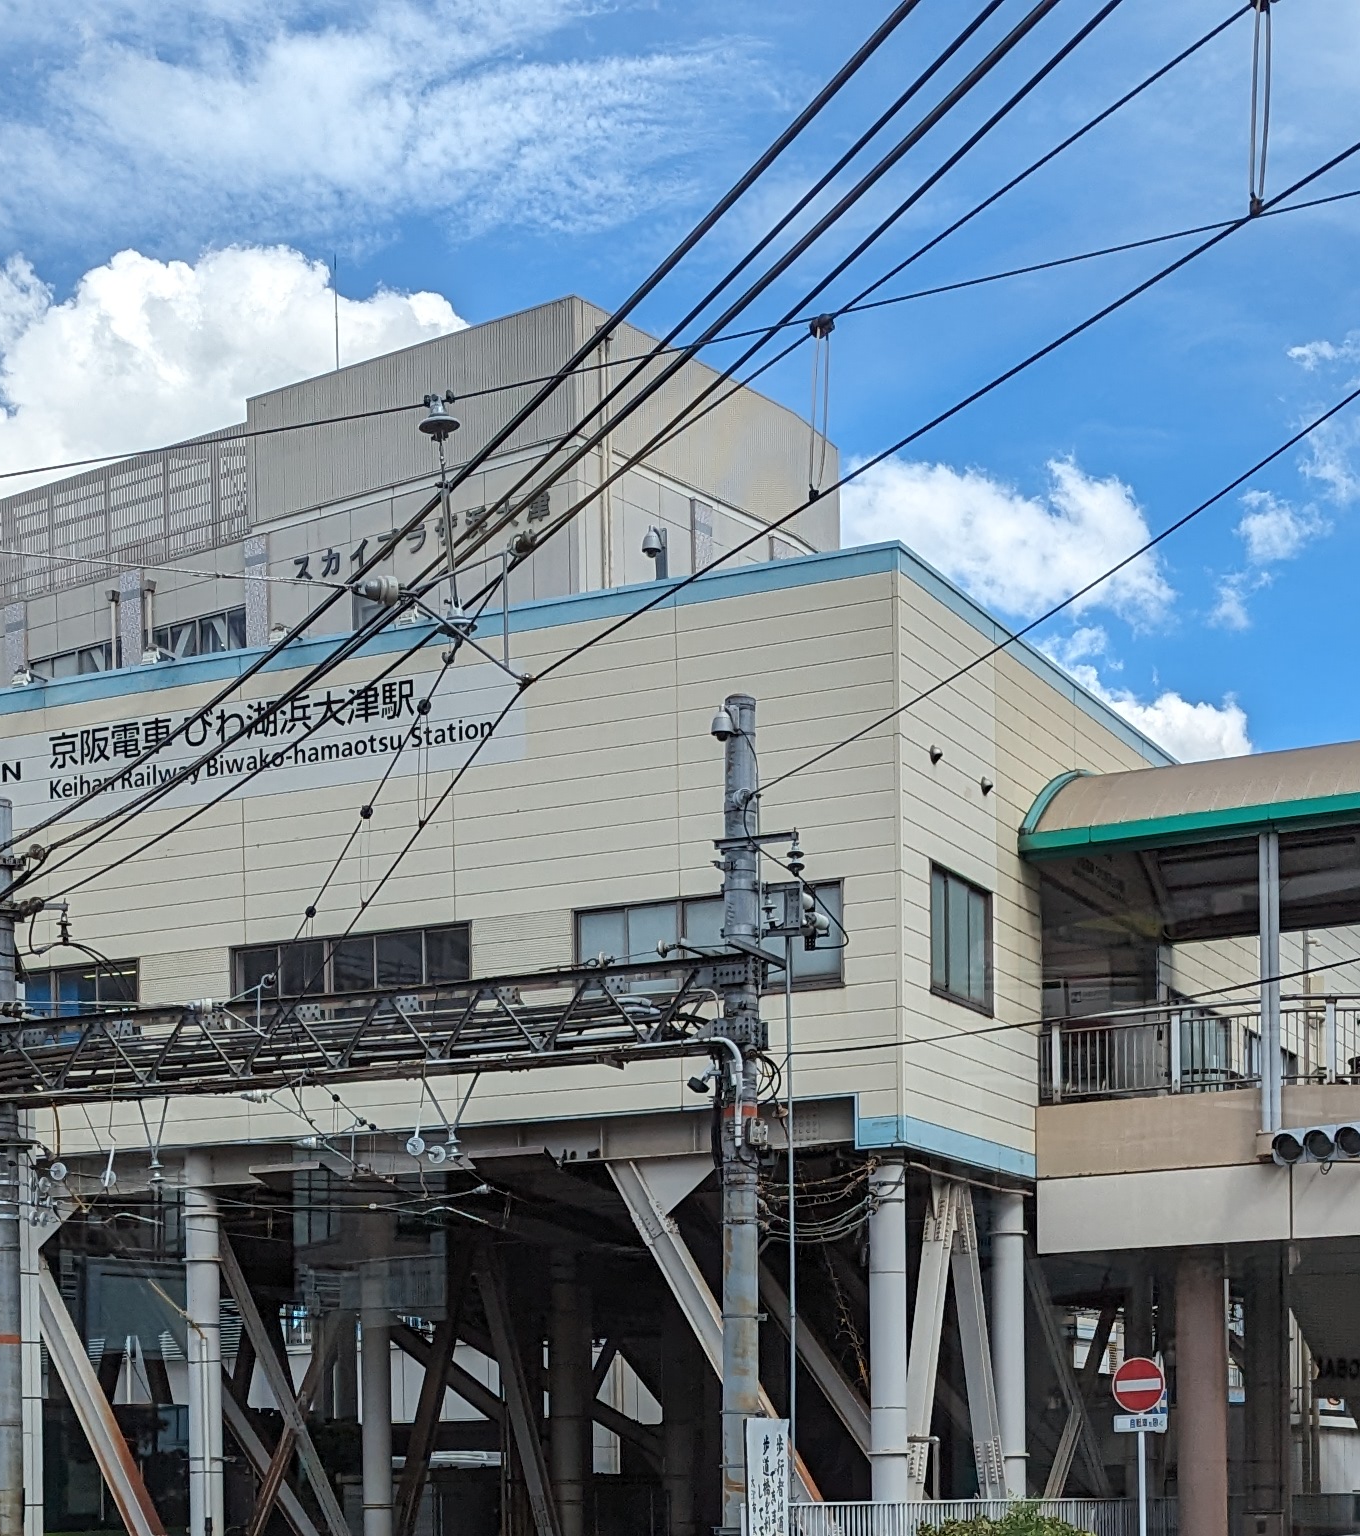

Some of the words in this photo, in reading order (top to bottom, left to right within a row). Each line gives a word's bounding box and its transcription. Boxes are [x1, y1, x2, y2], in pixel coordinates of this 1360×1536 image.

[49, 717, 172, 770] 京阪電車
[184, 679, 415, 748] びわ湖浜大津駅
[49, 773, 117, 800] Keihan
[122, 760, 199, 792] Railway
[206, 731, 403, 777] Biwako-hamaotsu
[411, 719, 494, 748] Station
